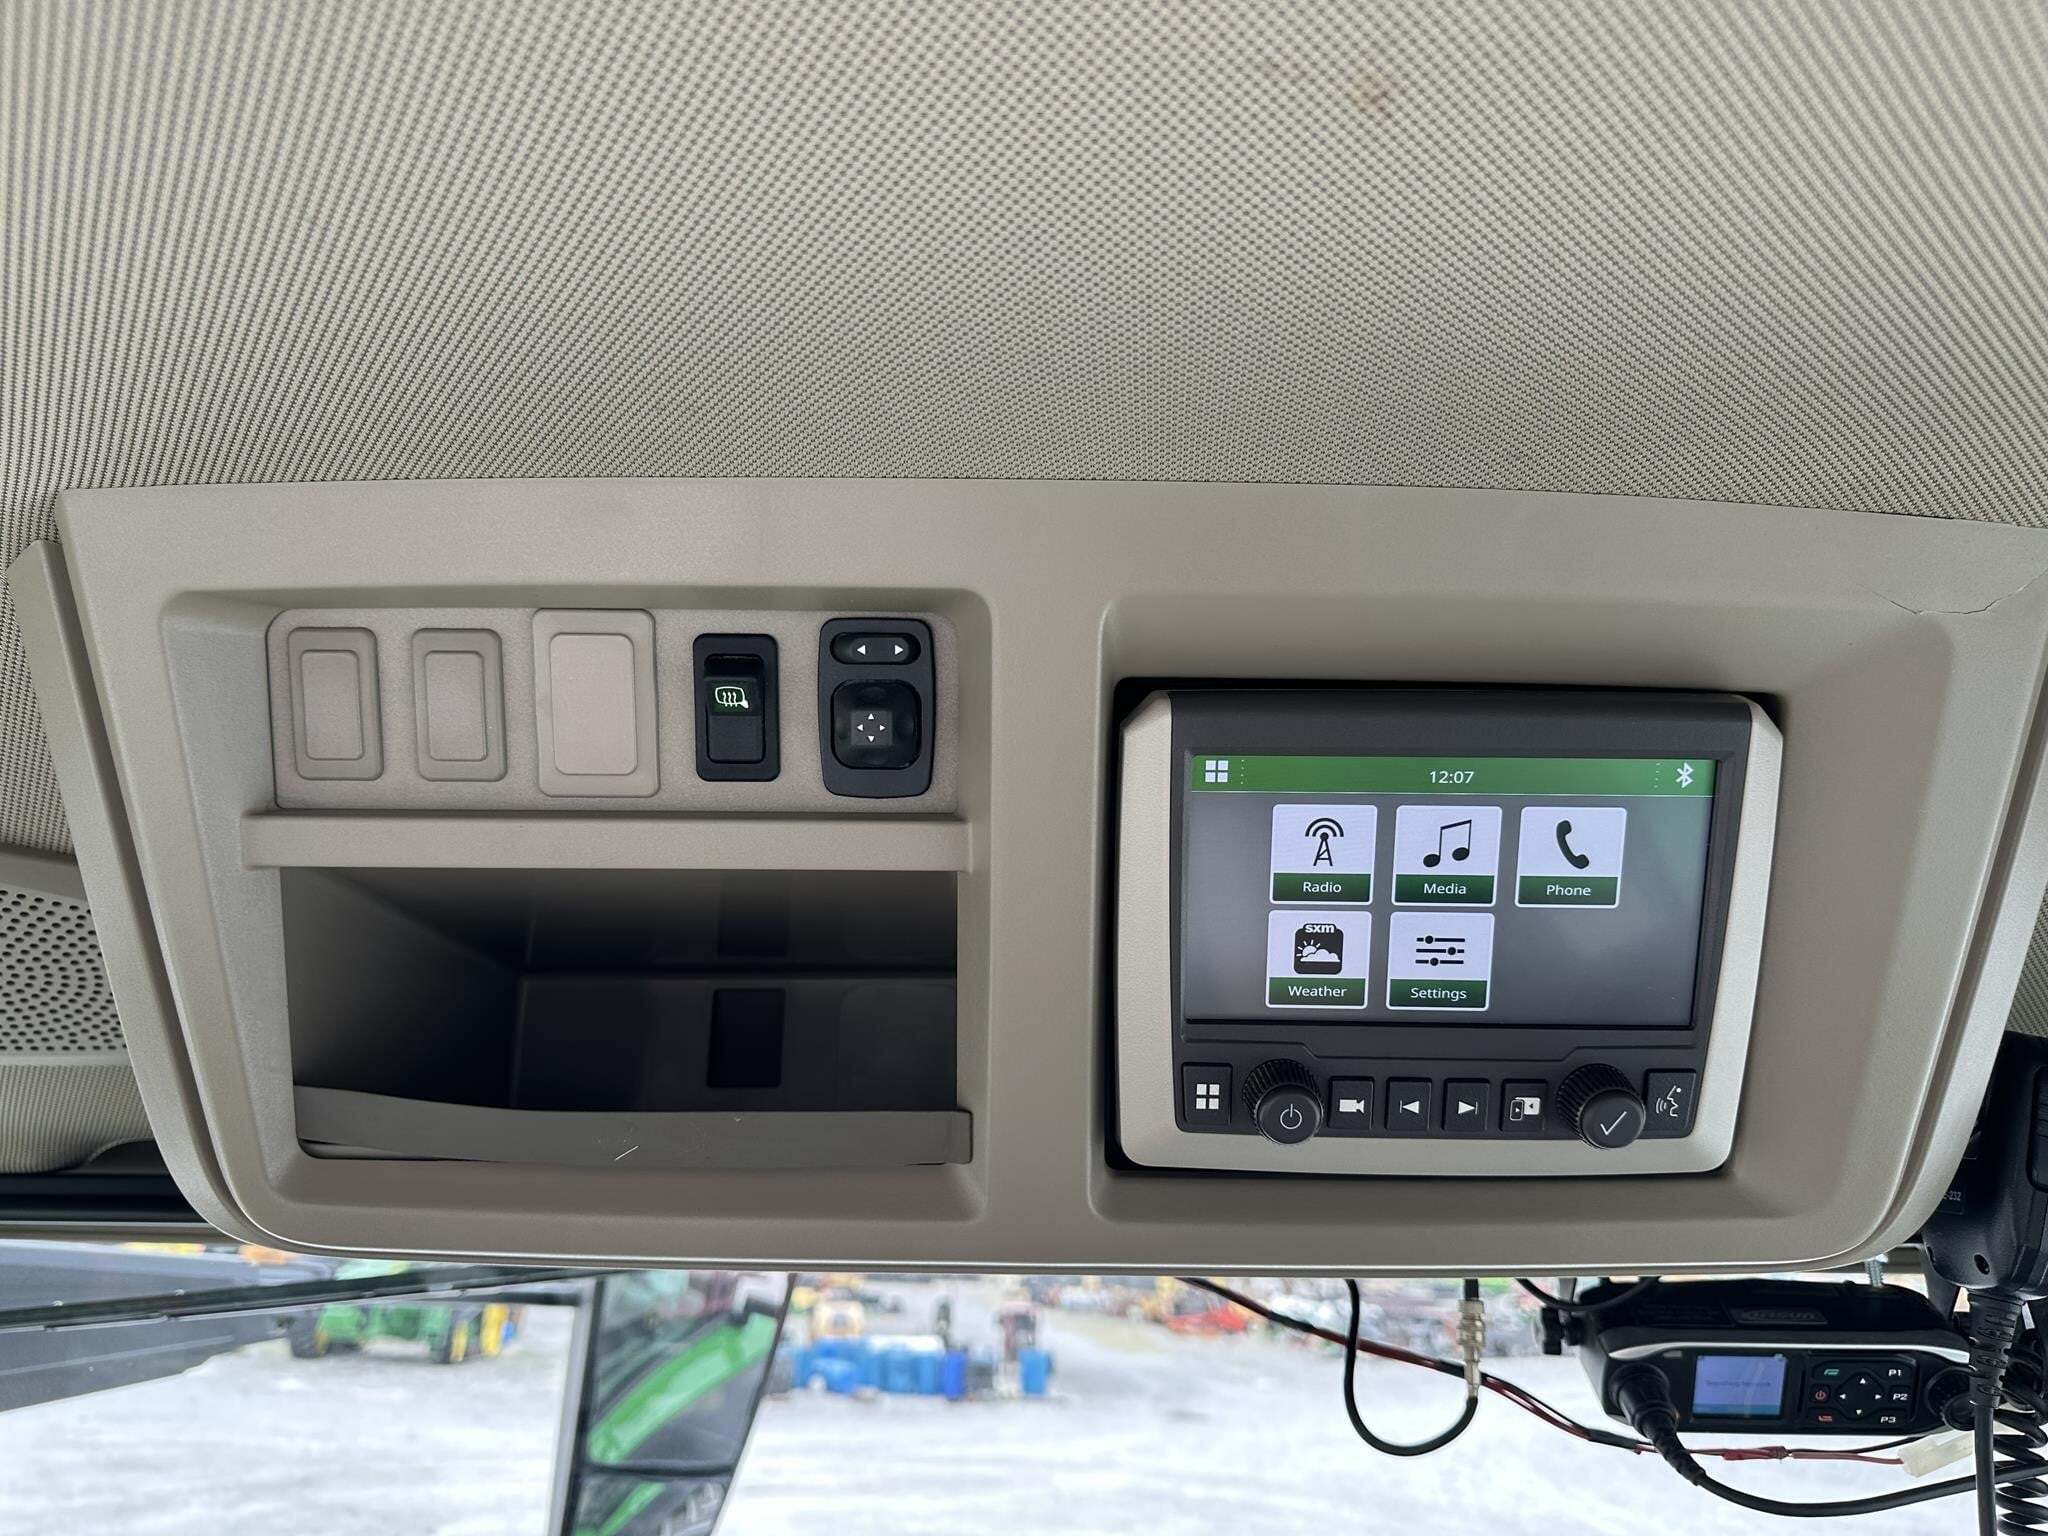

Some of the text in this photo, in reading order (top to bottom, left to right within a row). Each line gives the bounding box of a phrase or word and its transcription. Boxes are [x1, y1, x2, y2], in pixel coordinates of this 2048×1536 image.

[1429, 770, 1474, 784] 12:07
[1302, 881, 1342, 893] Radio
[1423, 883, 1467, 895] Media
[1546, 884, 1592, 896] Phone
[1304, 924, 1335, 934] sxm
[1288, 985, 1348, 997] Weather
[1410, 987, 1467, 1002] Settings
[1888, 1368, 1902, 1377] P1
[1893, 1393, 1908, 1401] P2
[1880, 1416, 1897, 1424] P3
